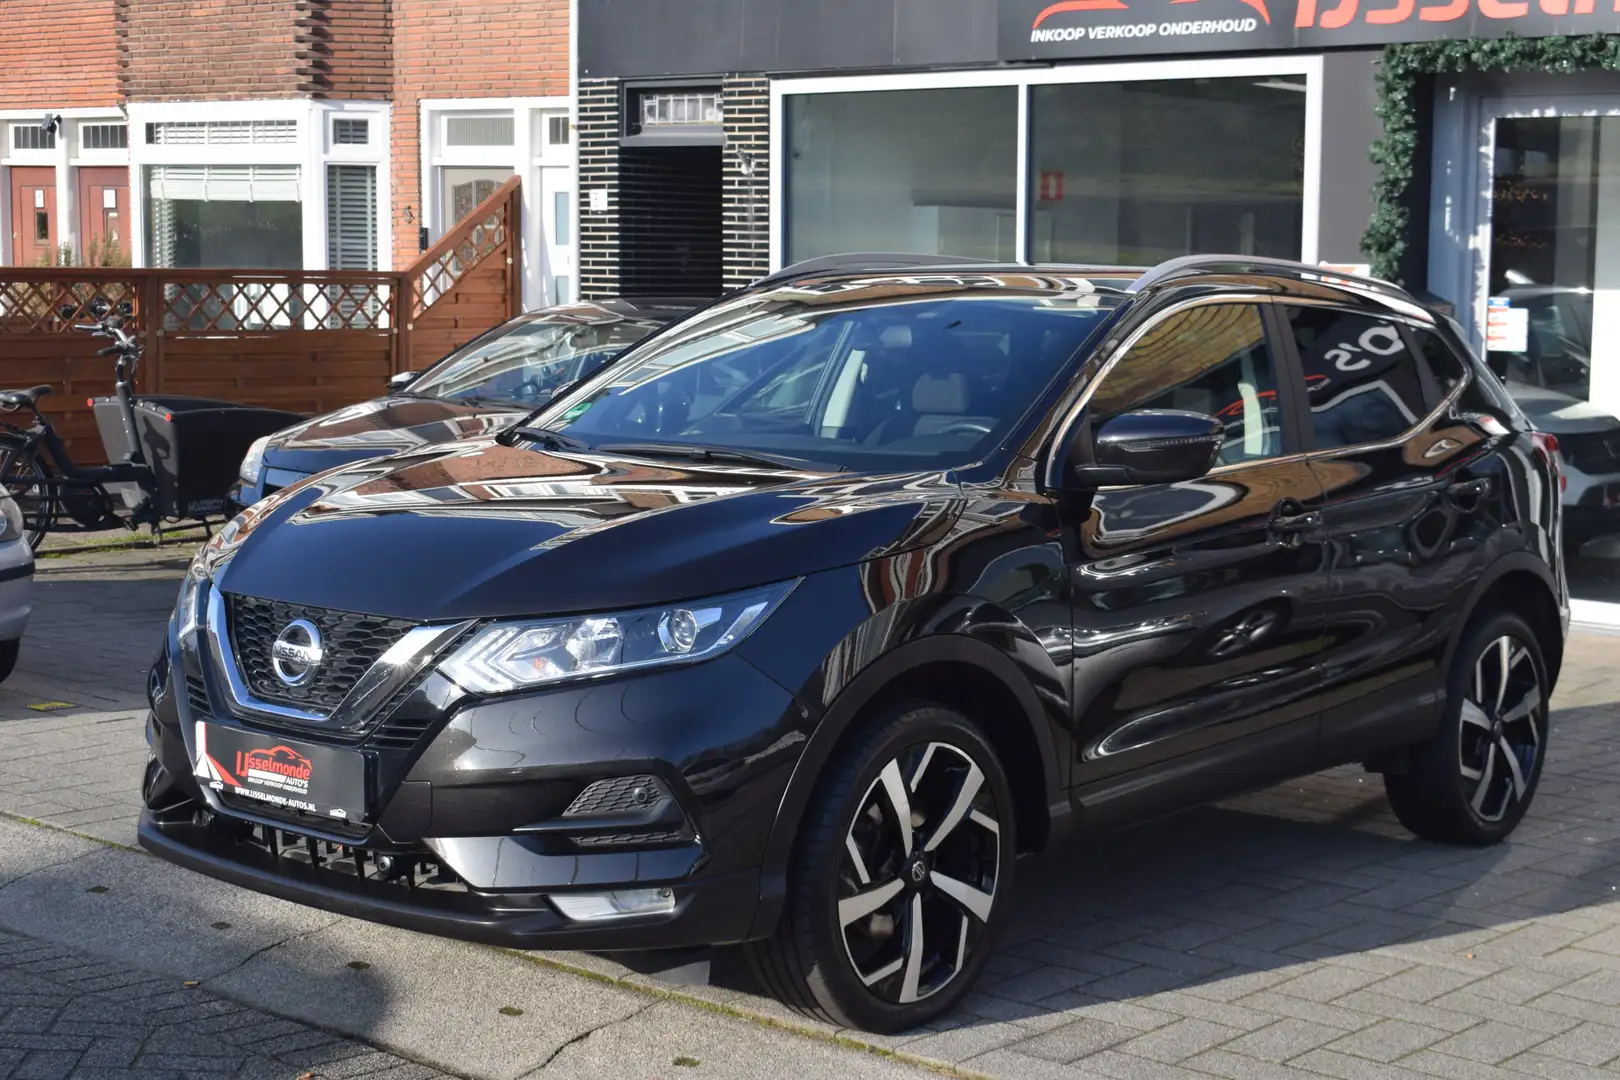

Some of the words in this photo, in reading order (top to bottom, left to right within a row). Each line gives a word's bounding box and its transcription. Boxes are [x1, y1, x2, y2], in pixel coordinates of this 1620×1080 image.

[1030, 29, 1085, 43] INKOOP
[1088, 24, 1157, 40] VERKOOP
[1159, 18, 1257, 37] ONDERHOUD
[274, 644, 312, 661] NISSAN
[283, 784, 308, 795] ONDERHOUD
[285, 776, 309, 788] AUTO'S
[234, 786, 317, 812] WWW.IJSSELMONDE-AUTOS.NL
